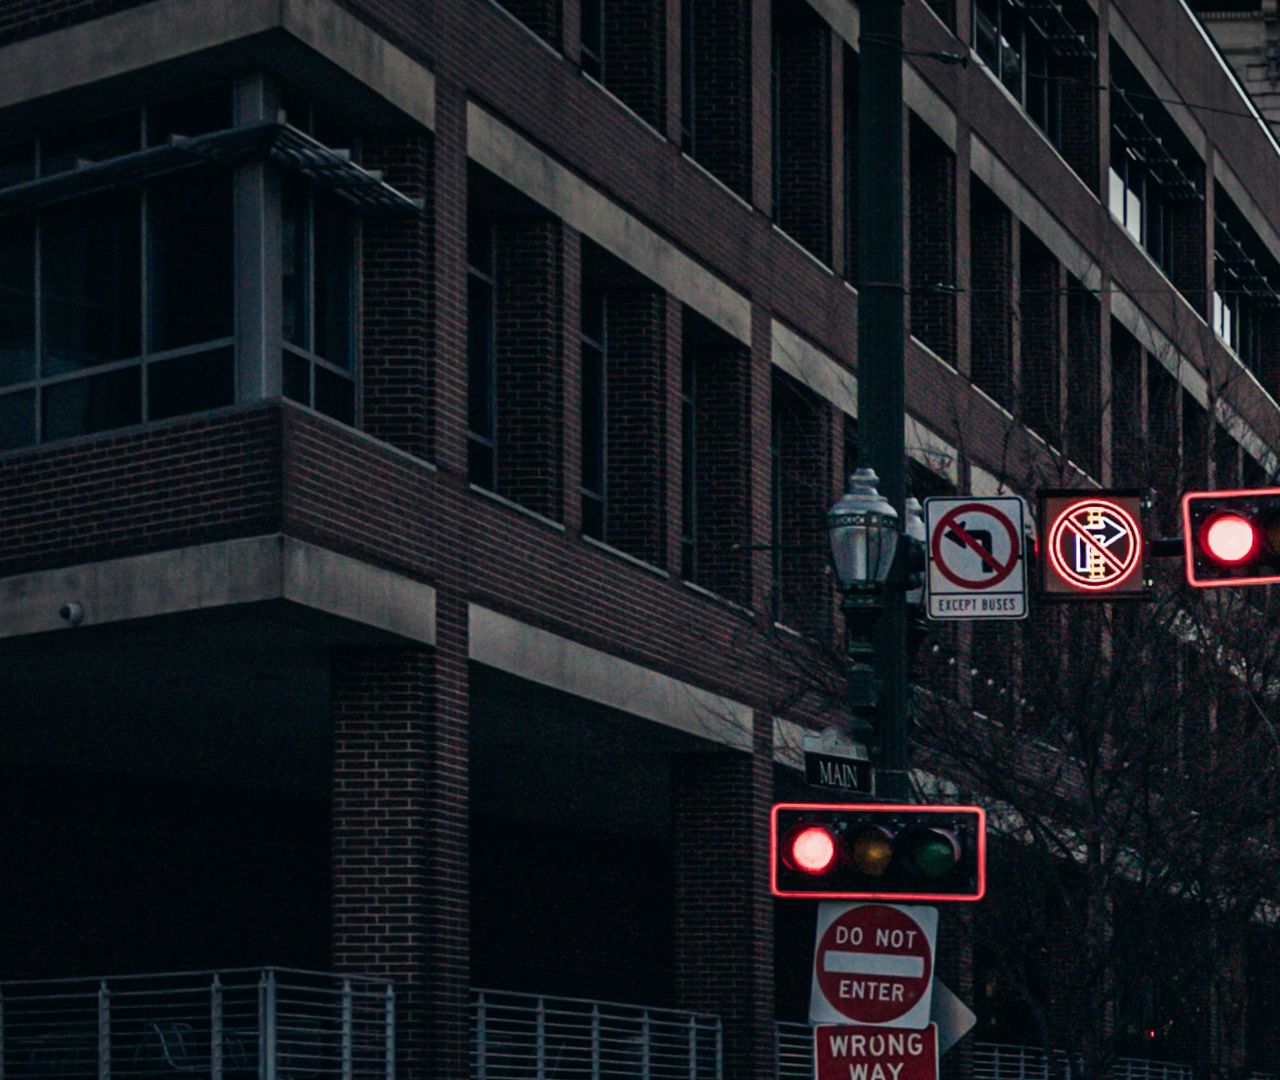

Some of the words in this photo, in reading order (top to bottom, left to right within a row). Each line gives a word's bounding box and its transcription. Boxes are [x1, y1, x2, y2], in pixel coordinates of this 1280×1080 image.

[939, 599, 976, 611] EXCEPT
[982, 598, 1015, 610] BUSES
[819, 760, 858, 788] MAIN
[835, 925, 864, 946] DO
[875, 928, 917, 949] NOT
[838, 979, 905, 1002] ENTER
[829, 1033, 924, 1057] WRONG
